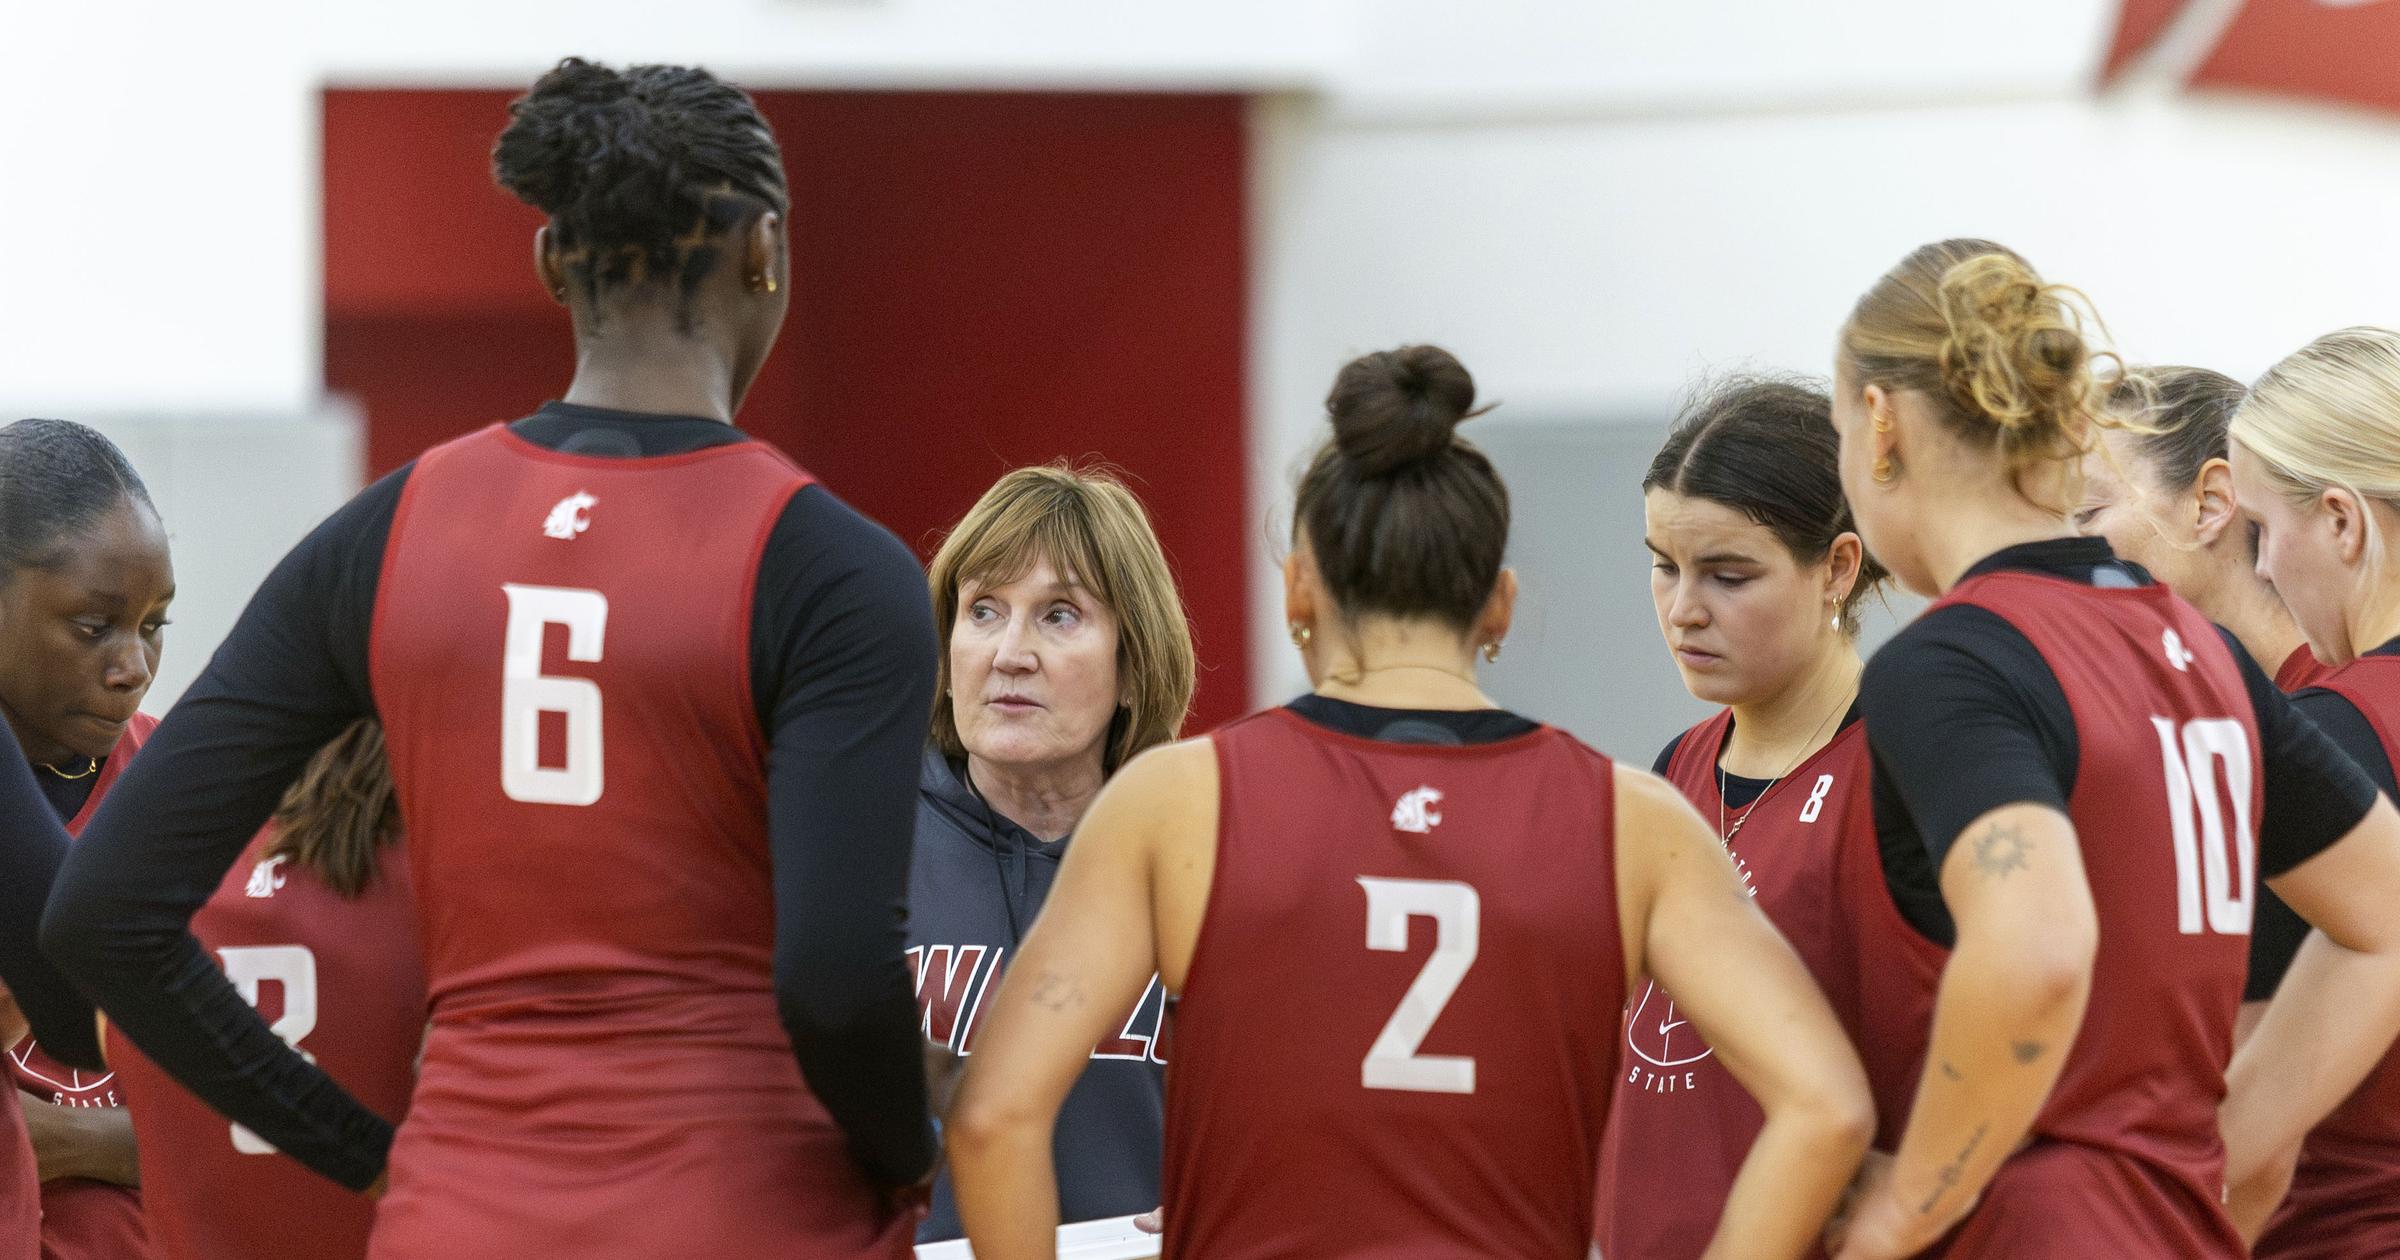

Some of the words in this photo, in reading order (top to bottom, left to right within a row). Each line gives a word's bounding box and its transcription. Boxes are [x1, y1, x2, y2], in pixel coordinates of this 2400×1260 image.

[500, 582, 608, 806] 6
[1799, 774, 1834, 823] 8
[2150, 715, 2255, 936] 10
[1354, 874, 1481, 1095] 2
[1628, 1065, 1696, 1094] STATE
